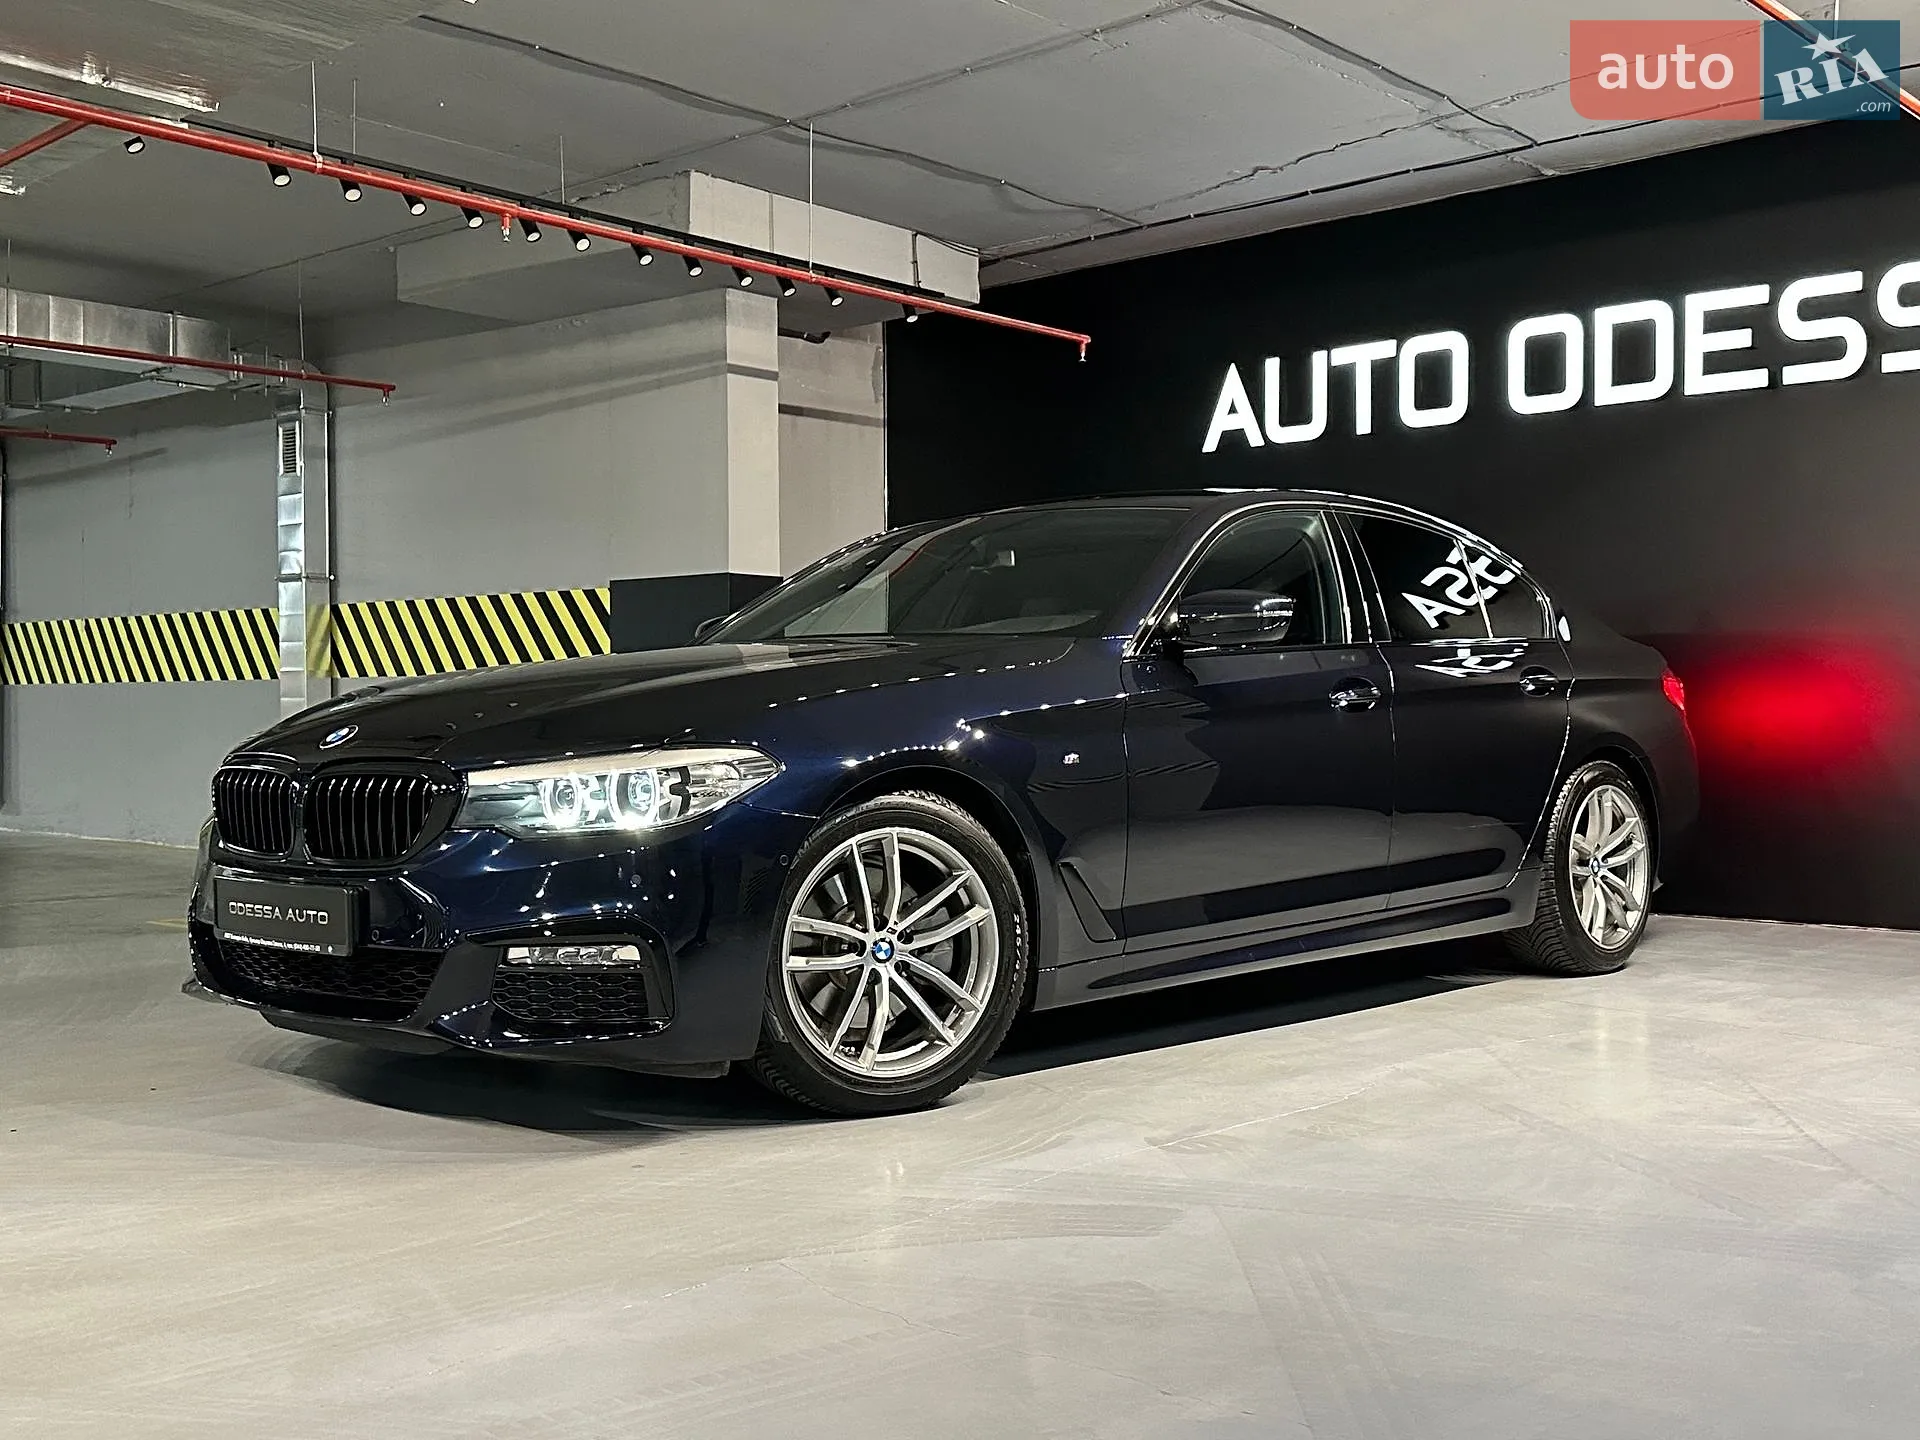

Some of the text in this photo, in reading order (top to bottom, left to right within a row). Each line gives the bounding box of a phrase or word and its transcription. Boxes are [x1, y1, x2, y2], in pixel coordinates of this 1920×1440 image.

[1201, 330, 1470, 453] AUTO
[228, 901, 329, 925] ODESSA AUTO
